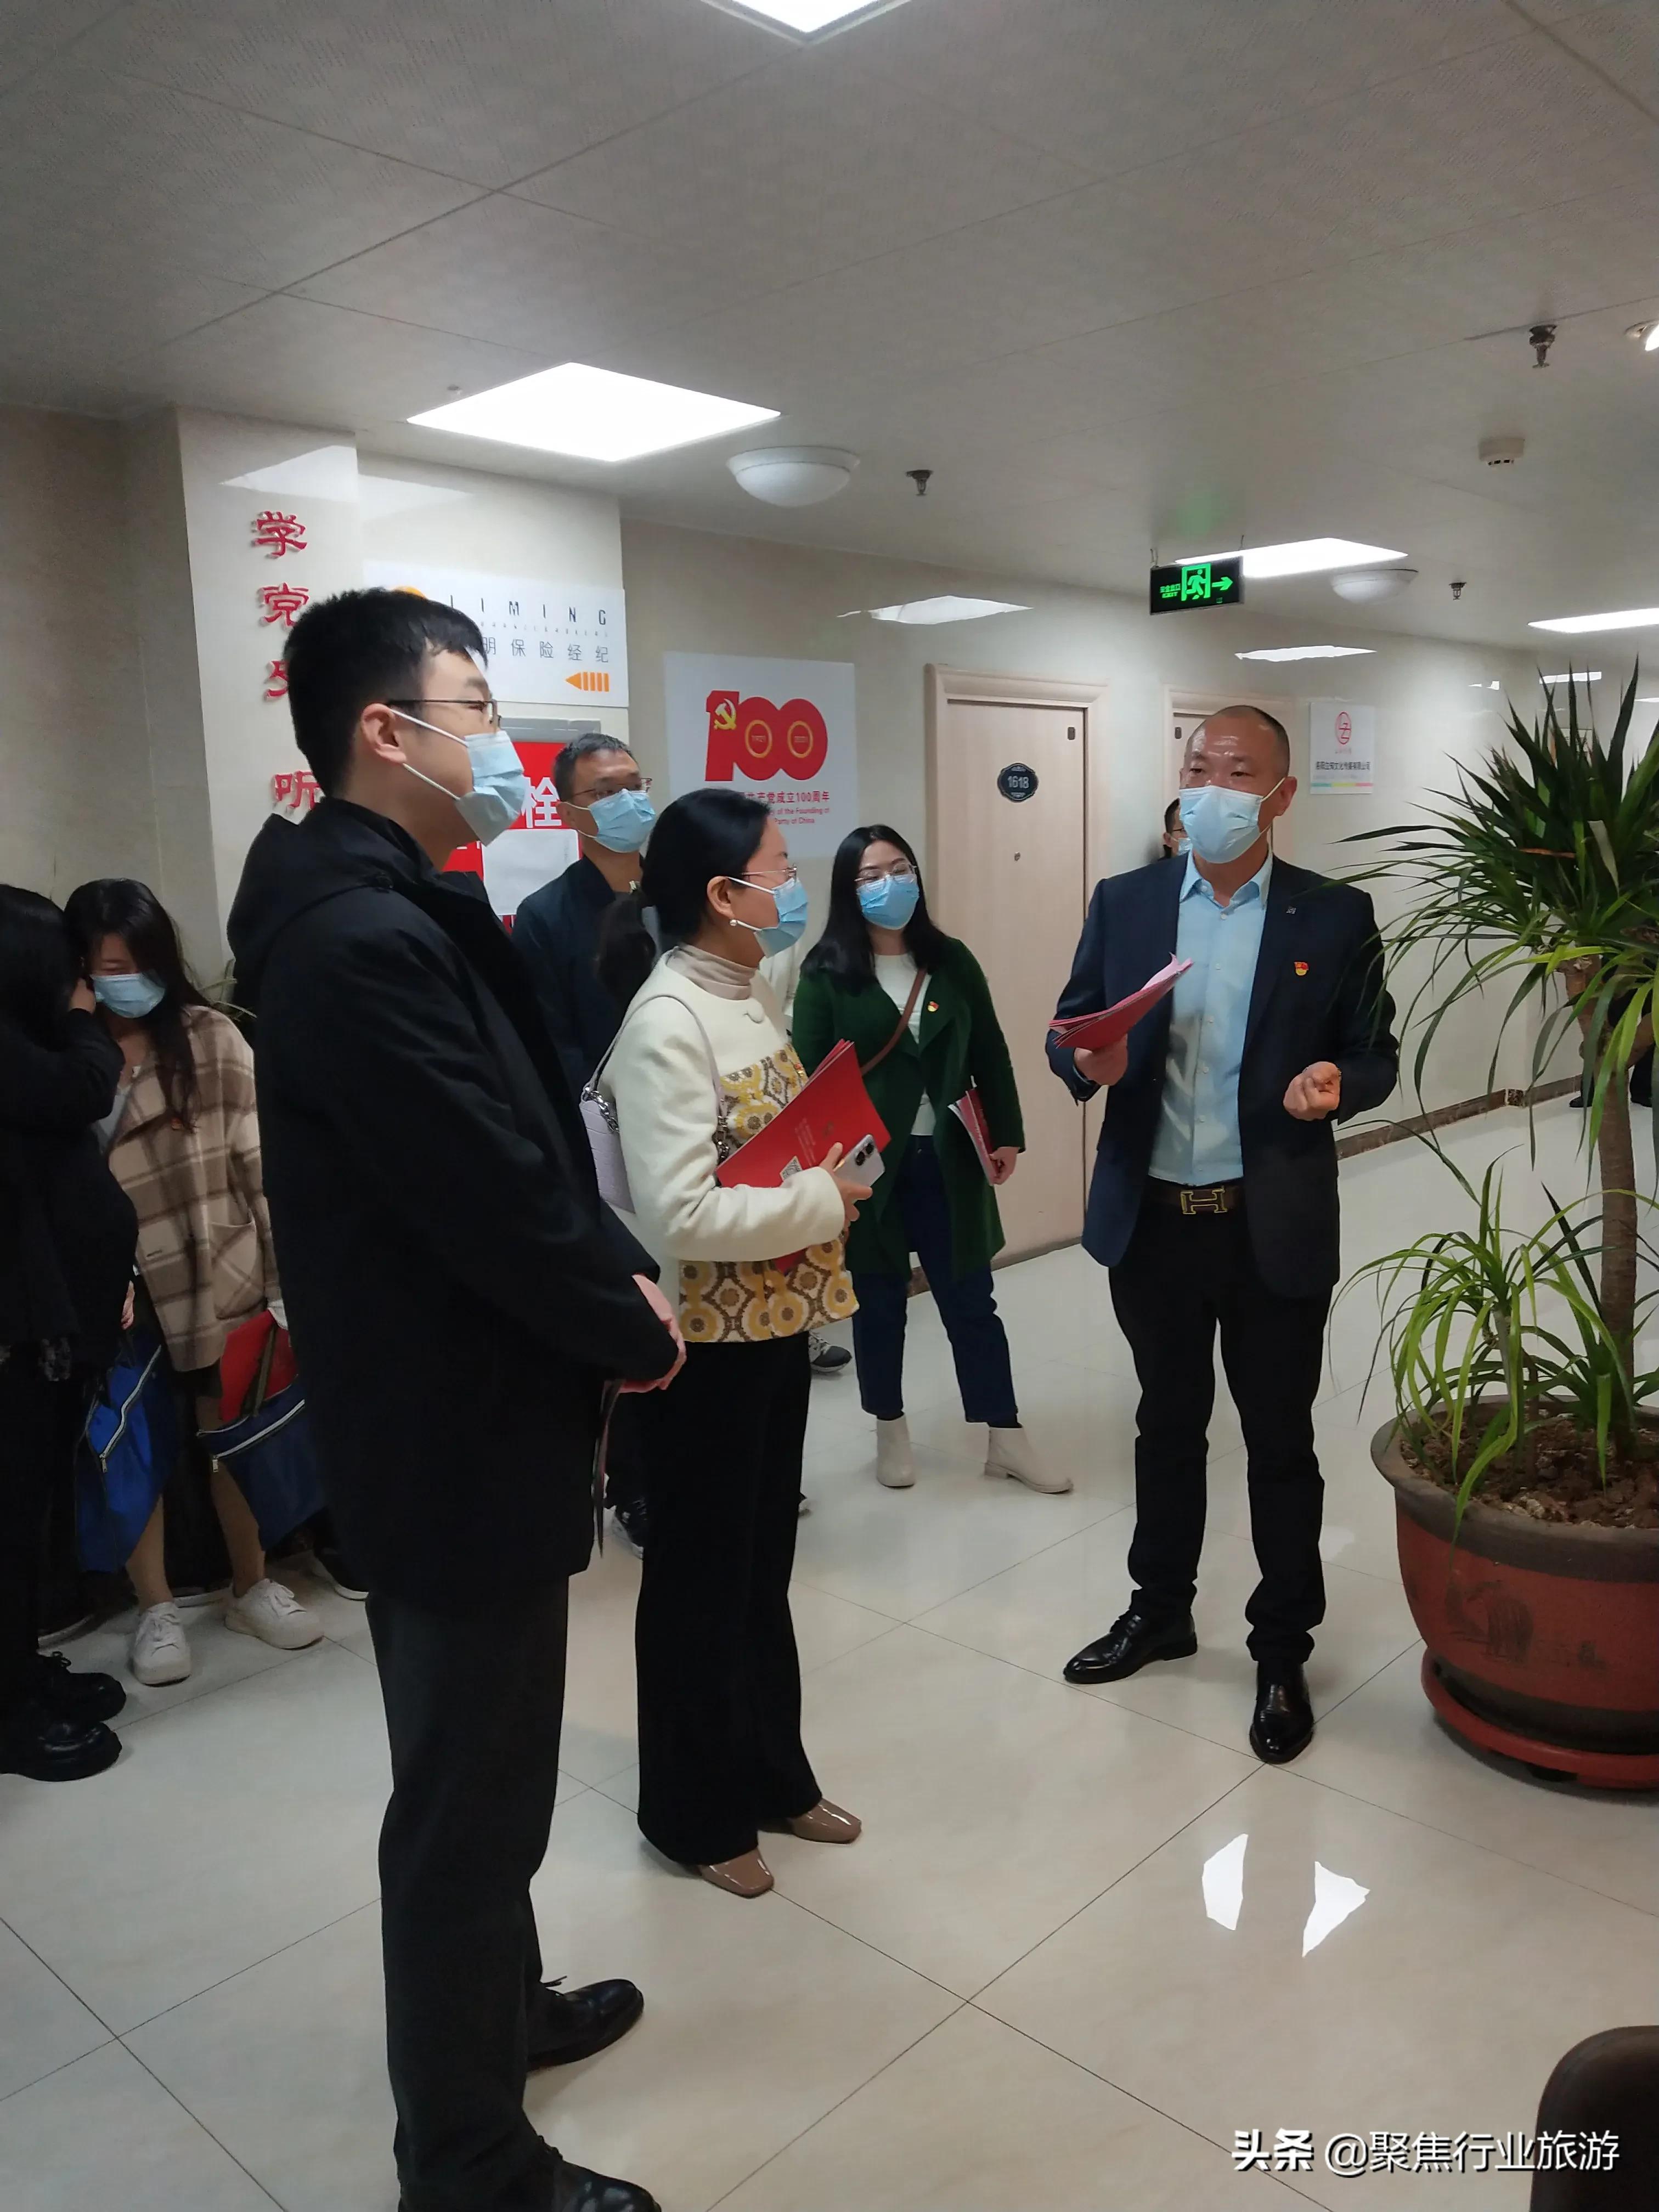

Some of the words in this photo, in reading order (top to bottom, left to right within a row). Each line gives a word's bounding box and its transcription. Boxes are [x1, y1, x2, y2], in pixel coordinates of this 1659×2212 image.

[483, 636, 609, 663] 明保险经纪
[1008, 775, 1029, 788] 1618
[520, 777, 562, 829] 栓
